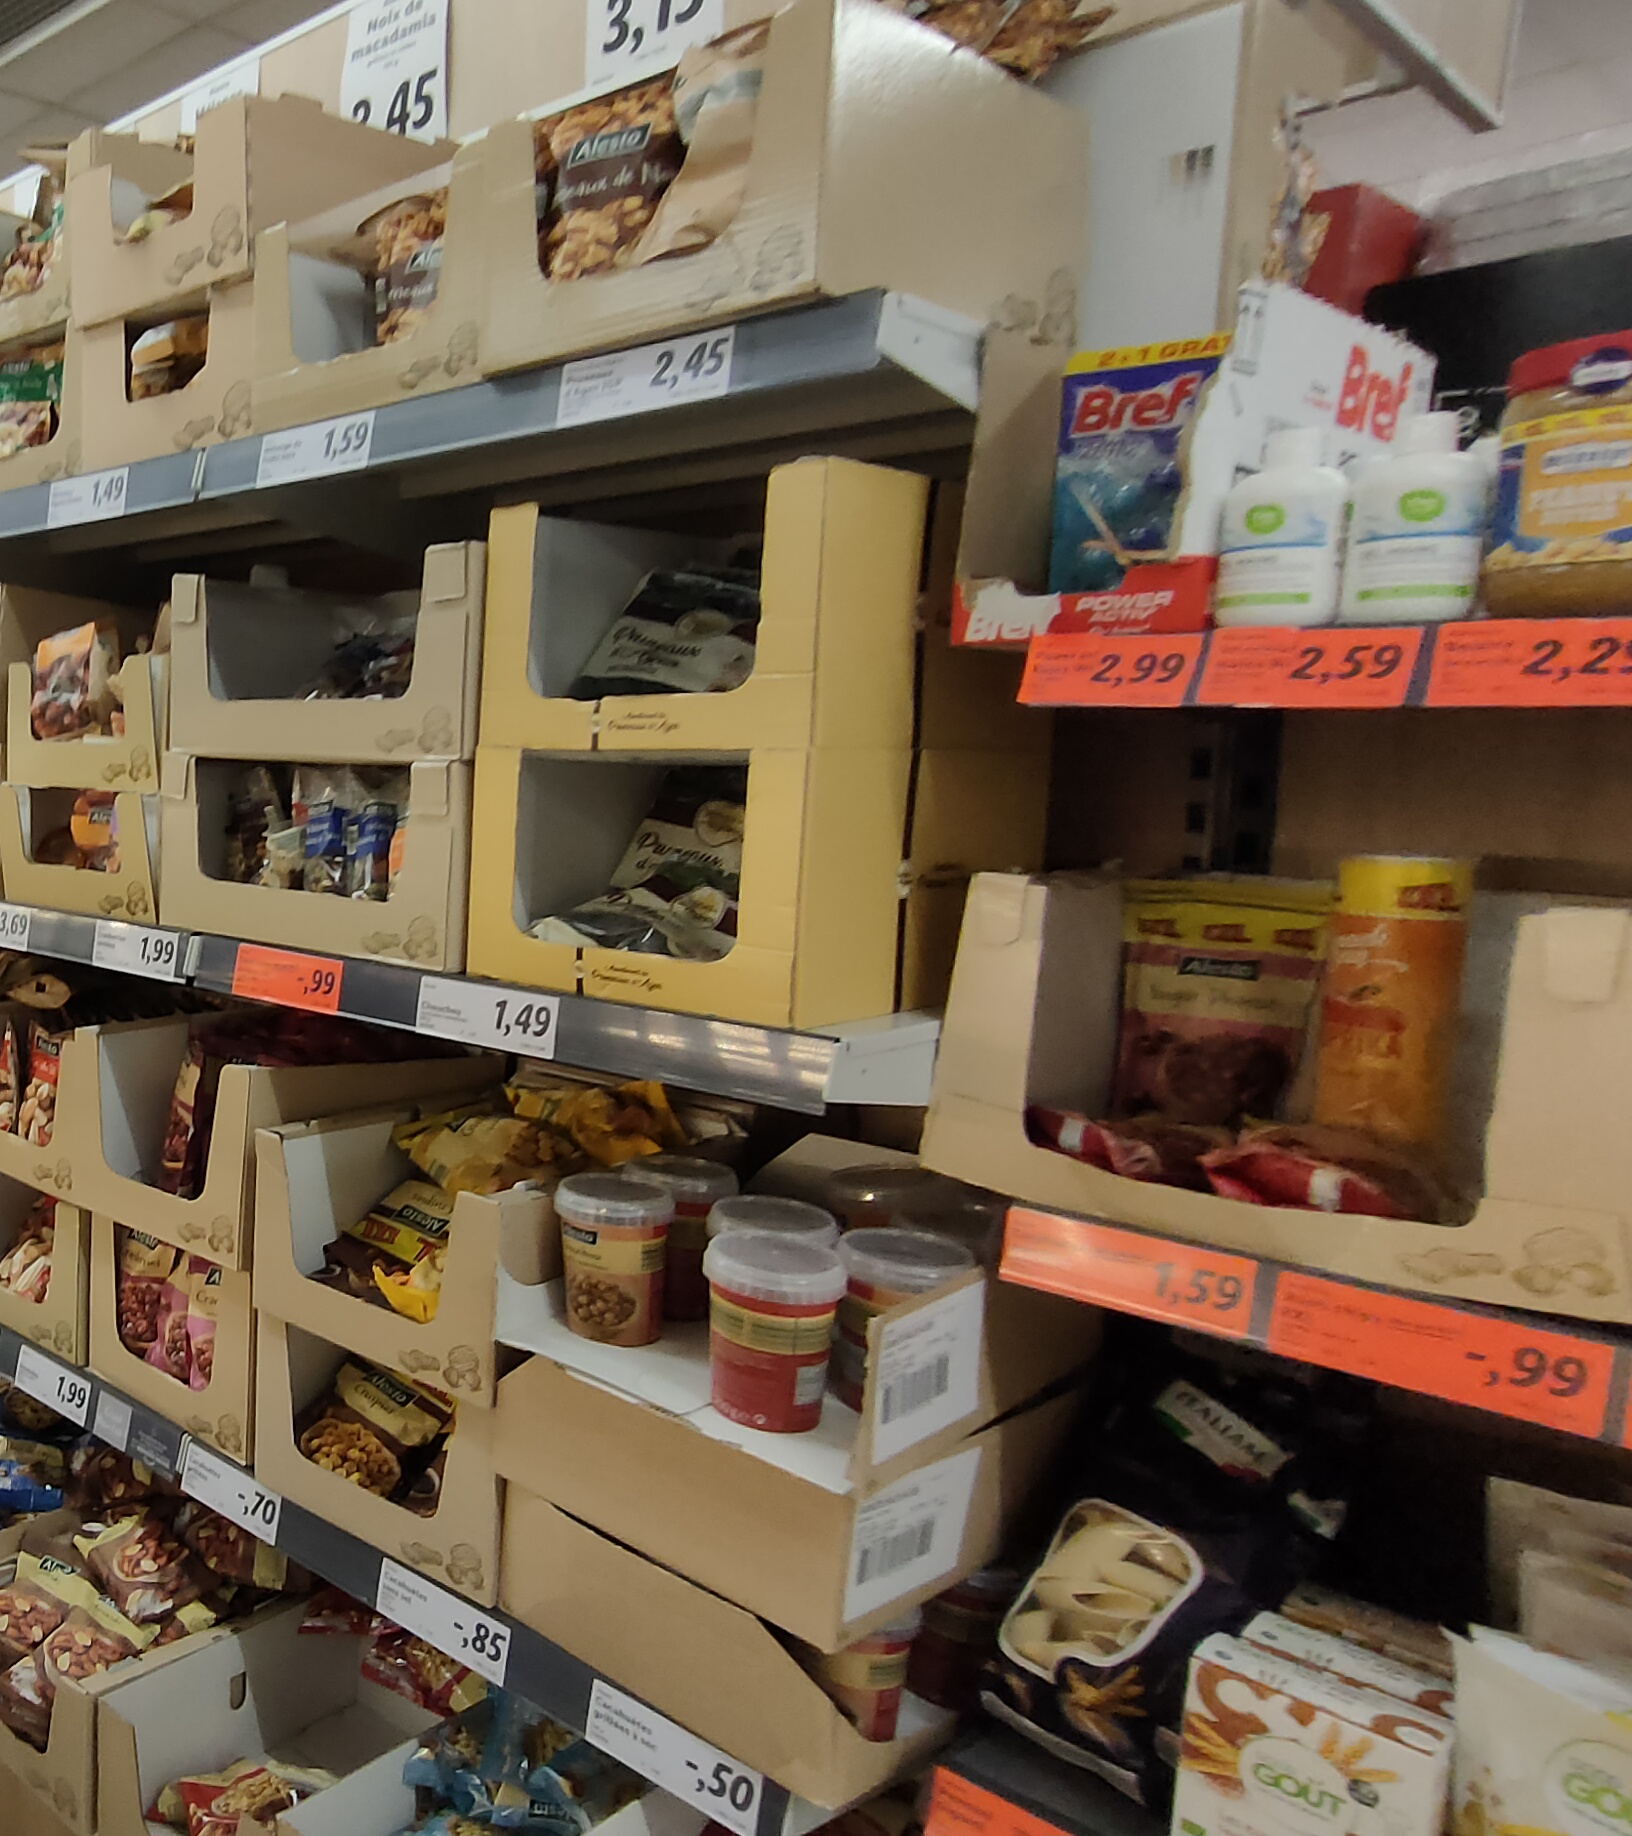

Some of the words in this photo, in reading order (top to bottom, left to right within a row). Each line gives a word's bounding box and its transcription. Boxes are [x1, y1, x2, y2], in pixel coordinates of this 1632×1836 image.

[352, 66, 438, 137] 45
[574, 128, 643, 160] Alesto
[649, 338, 730, 391] 2,45
[1070, 374, 1202, 437] Bref
[1335, 343, 1414, 443] Bref
[323, 422, 369, 462] 1,59
[92, 475, 125, 509] 1,49
[1091, 652, 1185, 687] 2,99
[1290, 645, 1403, 684] 2,59
[139, 936, 176, 966] 1,99
[296, 968, 336, 995] -,99
[495, 1000, 552, 1038] 1,49
[1152, 1261, 1243, 1311] 1,59
[1464, 1345, 1590, 1399] -,99
[57, 1375, 87, 1412] 1,99
[237, 1490, 277, 1525] -,70
[453, 1621, 507, 1663] -,85
[685, 1759, 755, 1813] -,50
